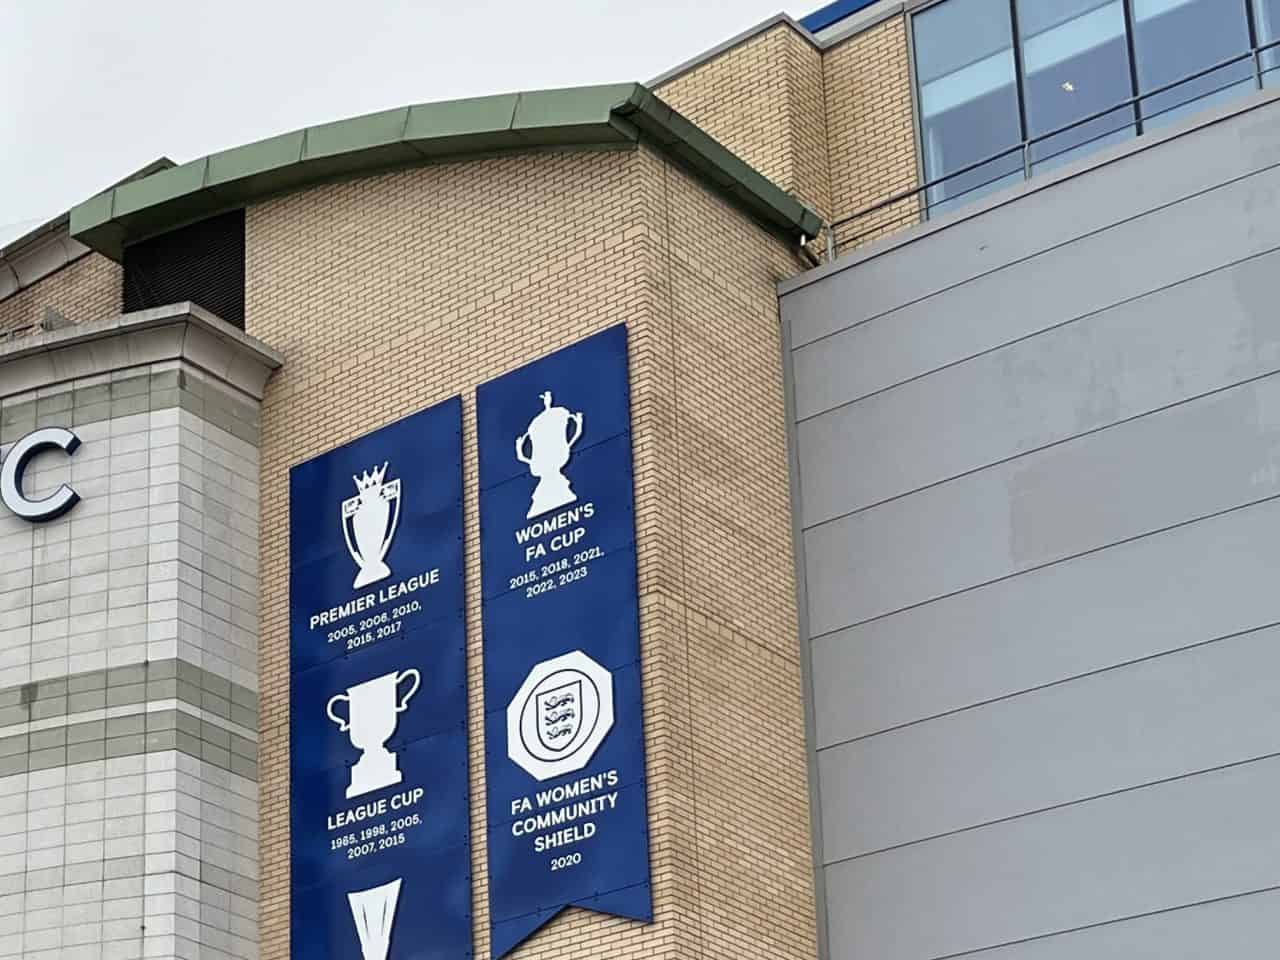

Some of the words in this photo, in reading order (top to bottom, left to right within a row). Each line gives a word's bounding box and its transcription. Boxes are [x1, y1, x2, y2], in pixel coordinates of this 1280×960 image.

[515, 503, 595, 544] WOMEN'S
[526, 543, 546, 562] FA
[550, 527, 585, 551] CUP
[559, 566, 588, 585] 2023
[310, 594, 375, 629] PREMIER
[379, 569, 440, 603] LEAGUE
[377, 621, 402, 640] 2017
[327, 799, 387, 830] LEAGUE
[390, 788, 424, 810] CUP
[511, 797, 532, 815] FA
[536, 770, 619, 807] WOMEN'S
[512, 792, 618, 836] COMMUNITY
[378, 833, 406, 850] 2015
[534, 822, 596, 852] SHIELD
[551, 852, 582, 871] 2020
